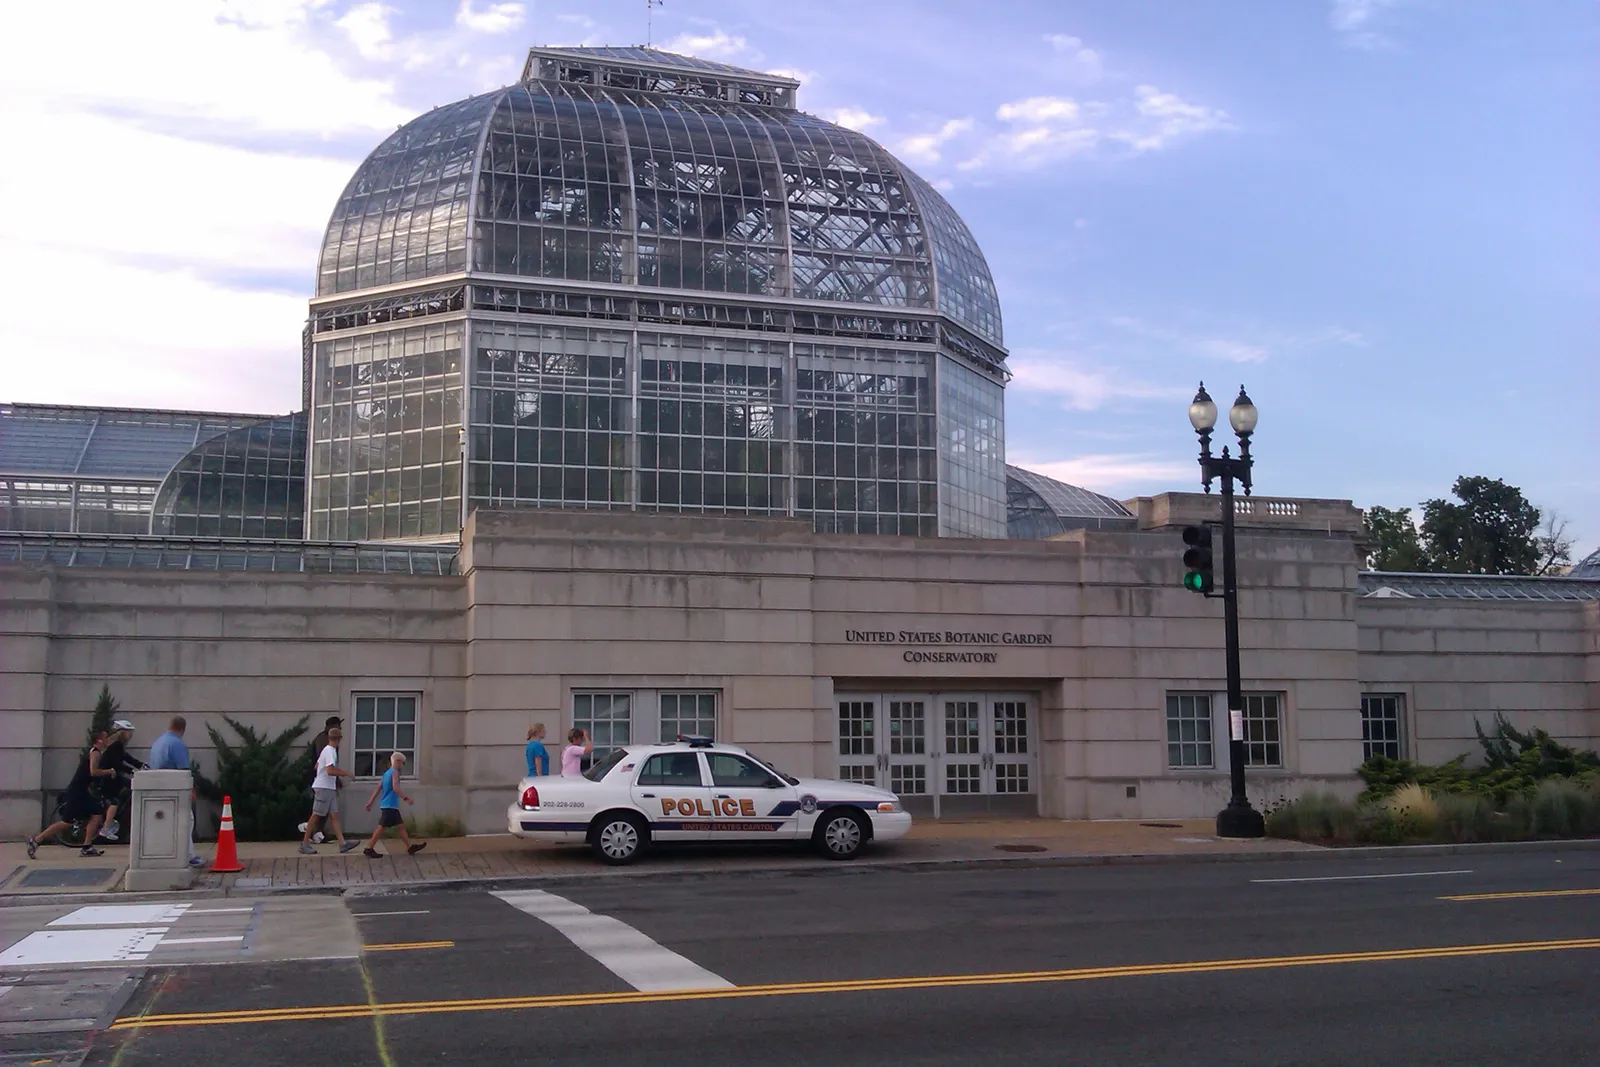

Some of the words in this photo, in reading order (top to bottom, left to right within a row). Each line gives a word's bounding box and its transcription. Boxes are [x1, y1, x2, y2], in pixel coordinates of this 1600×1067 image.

[845, 630, 895, 642] UNITED
[899, 631, 941, 643] STATES
[945, 631, 999, 644] BOTANIC
[1002, 632, 1052, 645] GARDEN
[903, 650, 998, 663] CONSERVATORY
[660, 798, 756, 816] POLICE
[682, 823, 709, 831] UNITED
[711, 823, 743, 831] STATES
[743, 823, 775, 831] CAPITOL
